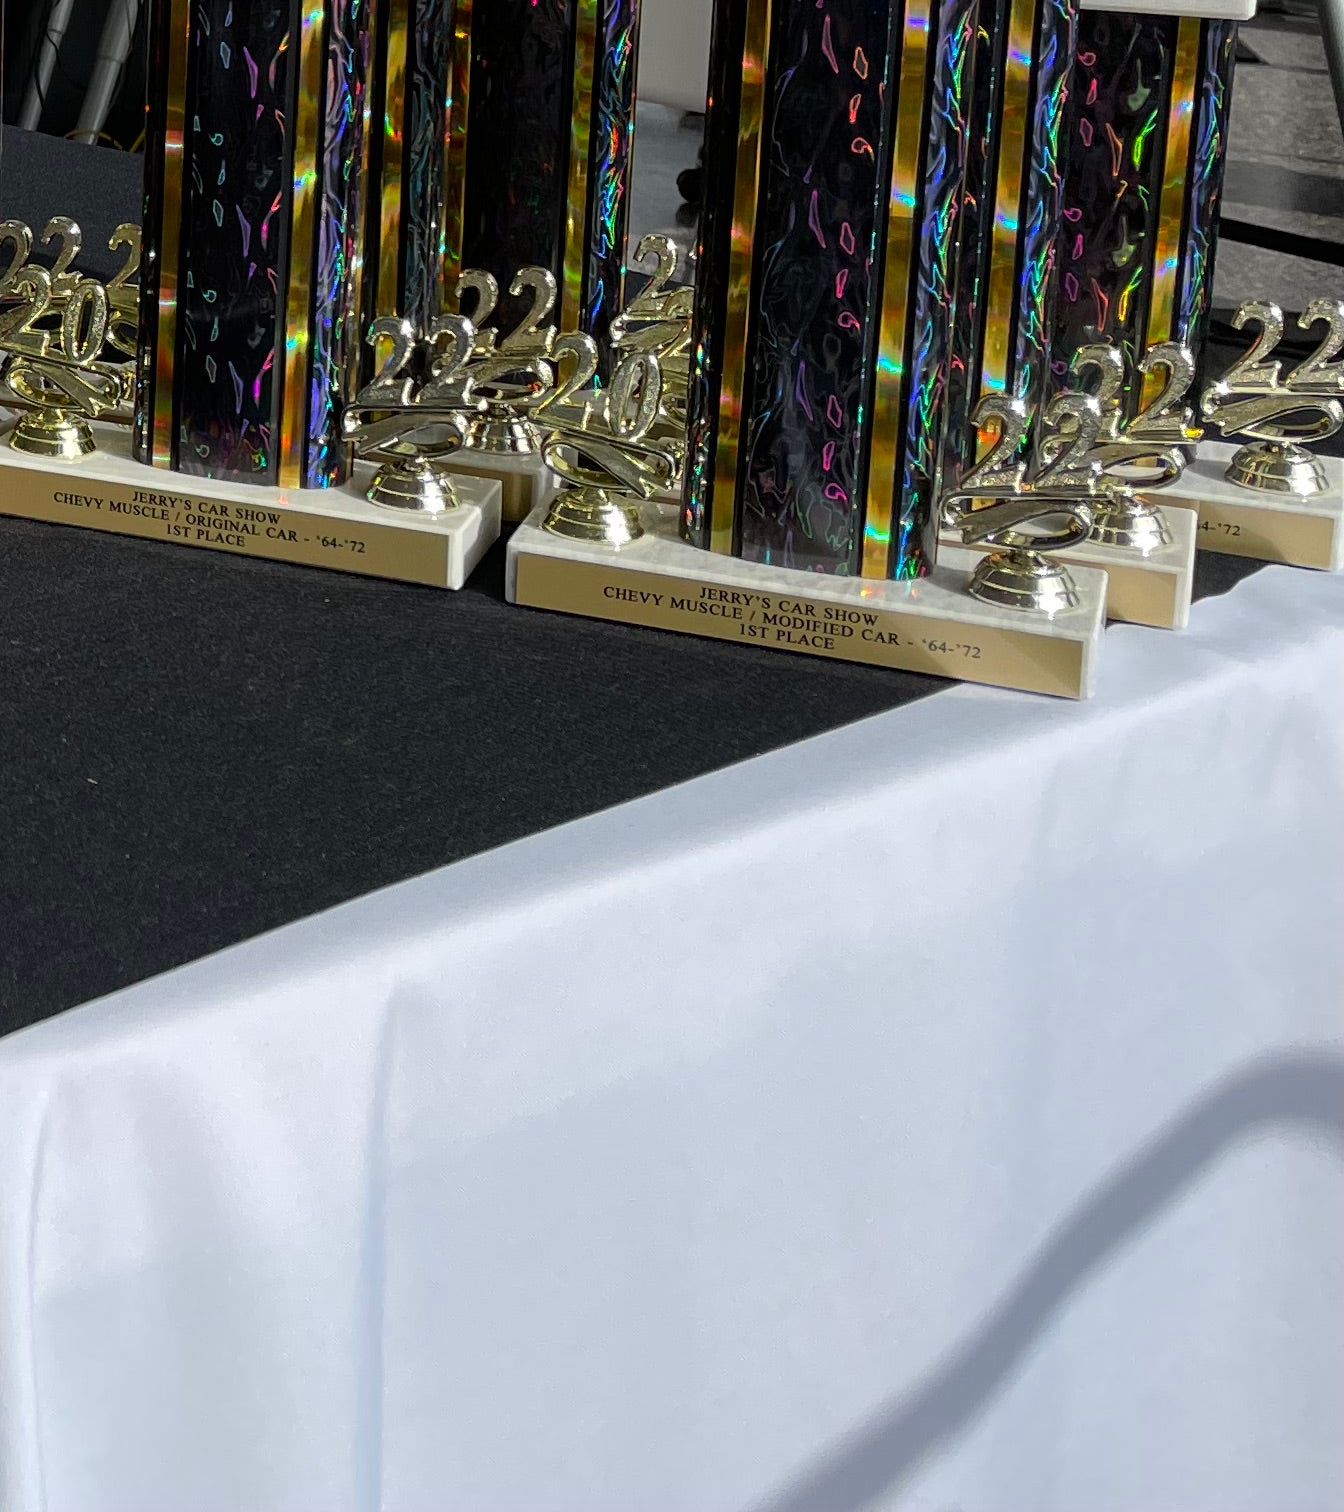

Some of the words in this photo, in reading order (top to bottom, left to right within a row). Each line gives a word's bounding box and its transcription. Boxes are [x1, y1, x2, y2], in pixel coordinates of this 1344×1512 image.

[53, 492, 104, 509] CHEVY
[109, 501, 169, 520] MUSCLE
[185, 514, 260, 536] ORIGINAL
[266, 528, 298, 542] CAR
[133, 490, 192, 511] JERRY'S
[198, 502, 230, 517] CAR
[236, 508, 281, 524] SHOW
[167, 524, 189, 538] 1ST
[196, 529, 246, 547] PLACE
[604, 586, 664, 606] CHEVY
[670, 597, 743, 620] MUSCLE
[763, 613, 854, 638] MODIFIED
[862, 628, 900, 646] CAR
[699, 587, 771, 609] JERRY'S
[779, 599, 816, 616] CAR
[824, 608, 879, 626] SHOW
[740, 624, 770, 639] 1ST
[776, 630, 835, 650] PLACE
